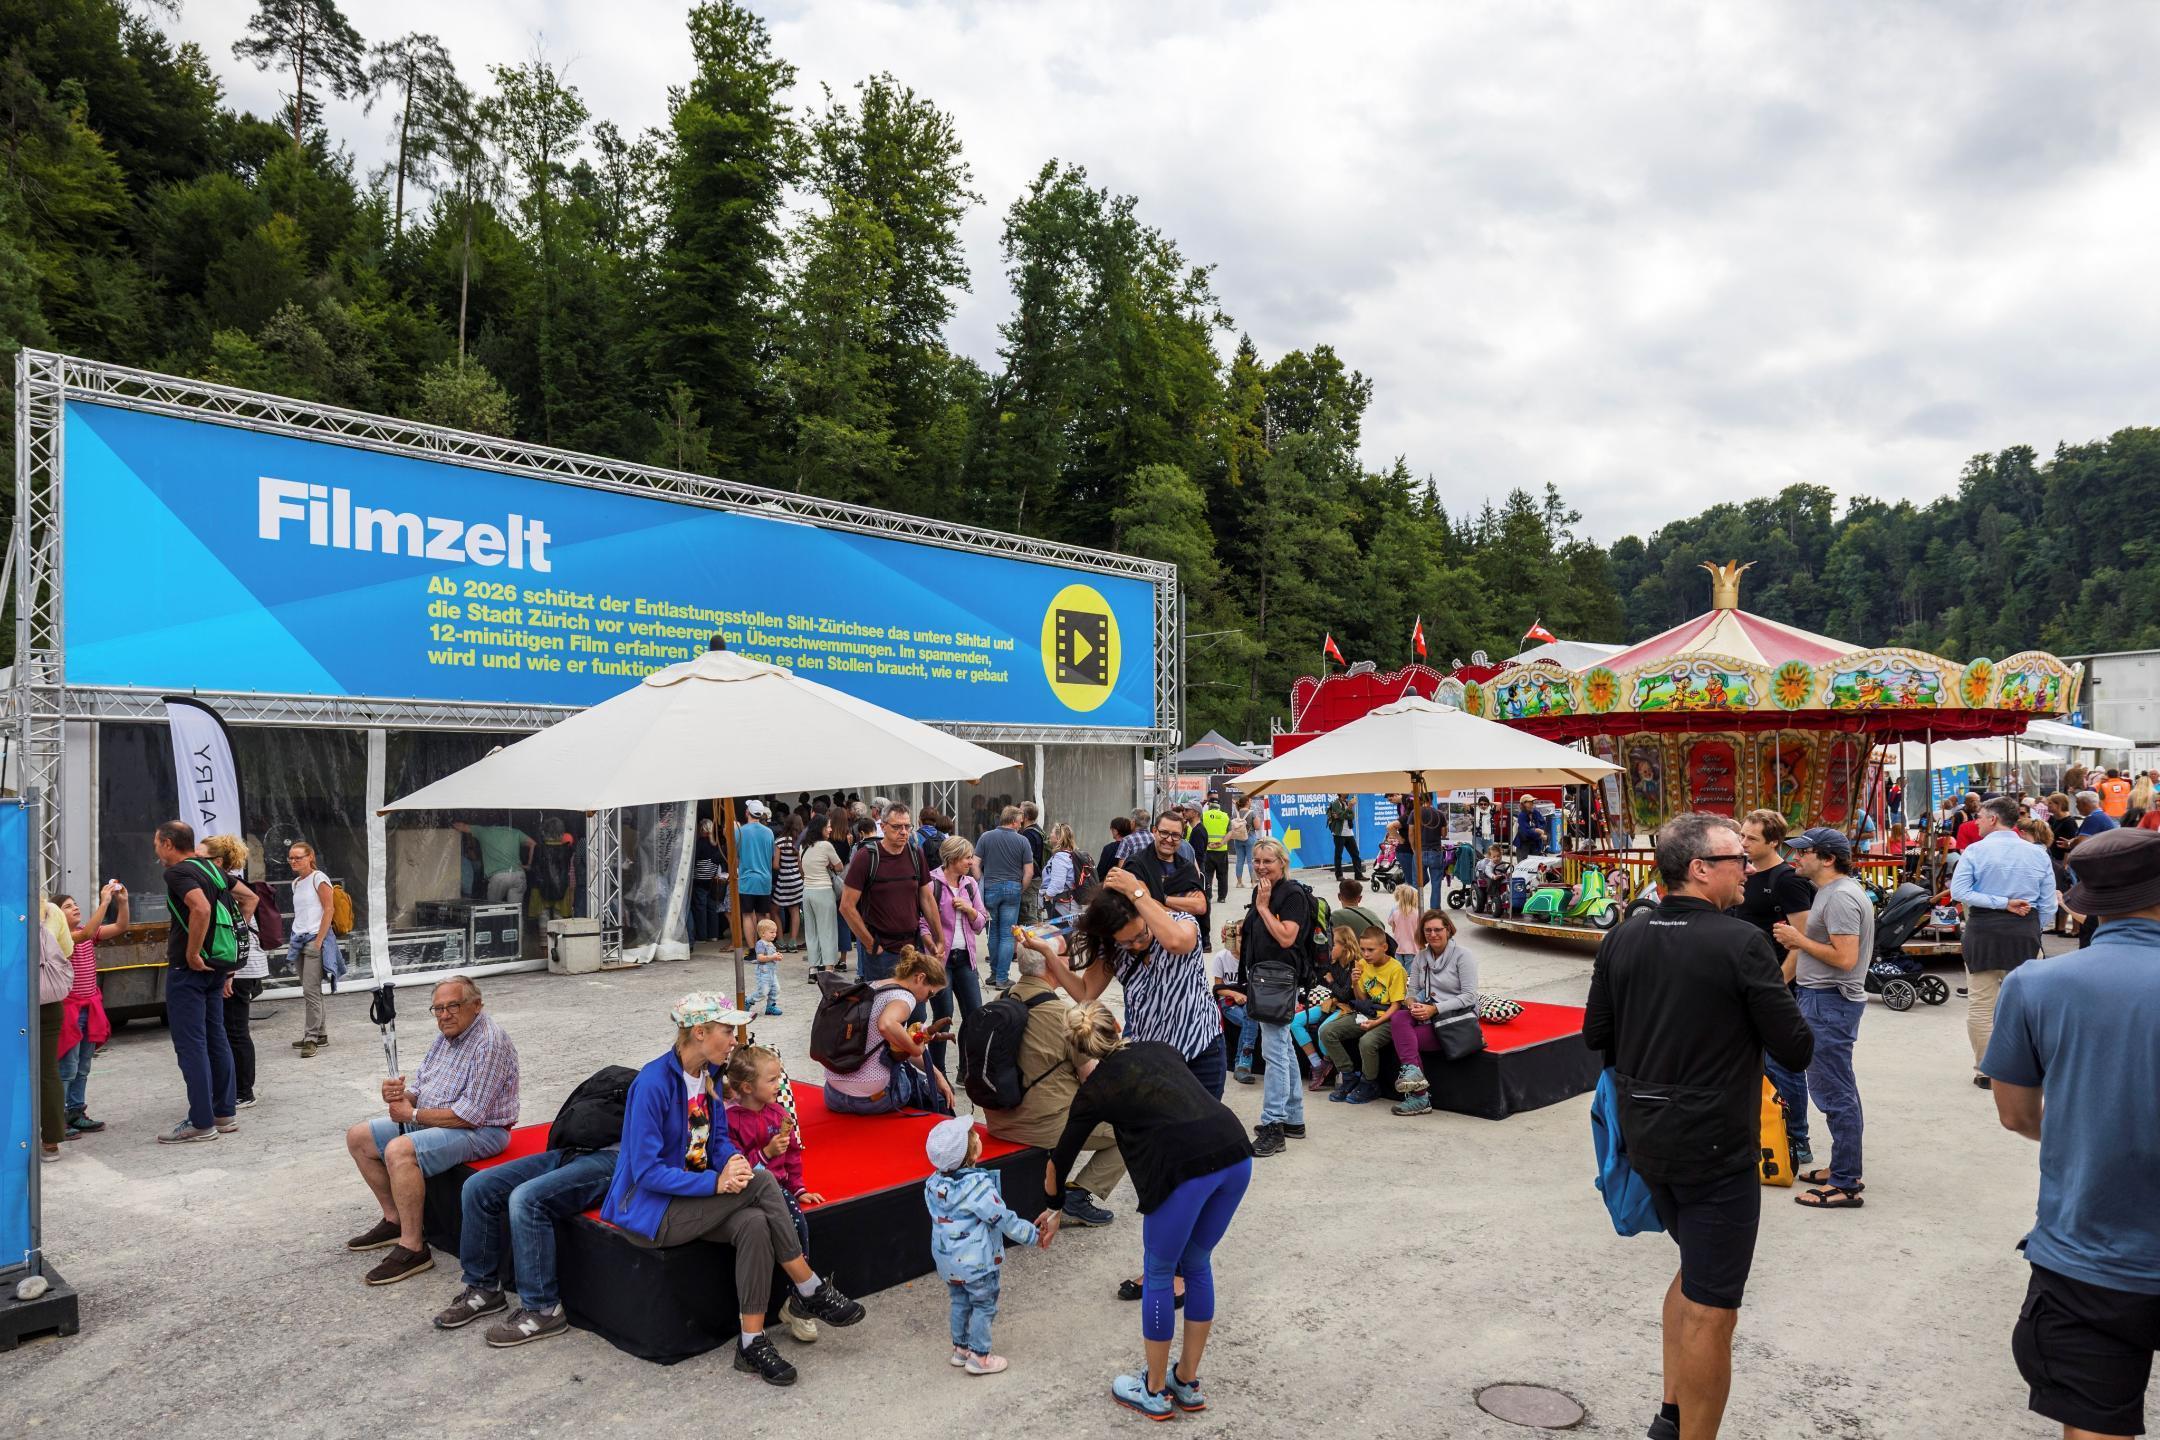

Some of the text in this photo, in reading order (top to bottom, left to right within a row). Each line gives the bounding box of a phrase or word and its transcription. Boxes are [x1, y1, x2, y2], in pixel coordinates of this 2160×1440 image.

[258, 476, 552, 573] Filmzelt
[427, 576, 1014, 651] Ab 2026 schützt der Entlastungsstollen Sihl-Zürichsee das untere Sihltal und
[428, 600, 461, 620] die
[467, 602, 522, 625] Stadt
[528, 608, 590, 631] Zürich
[595, 617, 625, 634] vor
[746, 627, 896, 659] Überschwemmungen.
[899, 644, 916, 659] Im
[918, 649, 993, 668] spannenden,
[428, 647, 476, 667] wird
[482, 651, 521, 669] und
[526, 655, 561, 671] wie
[567, 659, 586, 673] er
[430, 623, 1009, 684] 12-minütigen Film erfahren Si ieso es den Stollen braucht, wie er gebaut
[1280, 794, 1296, 804] Das
[1281, 804, 1327, 818] zum Projekt
